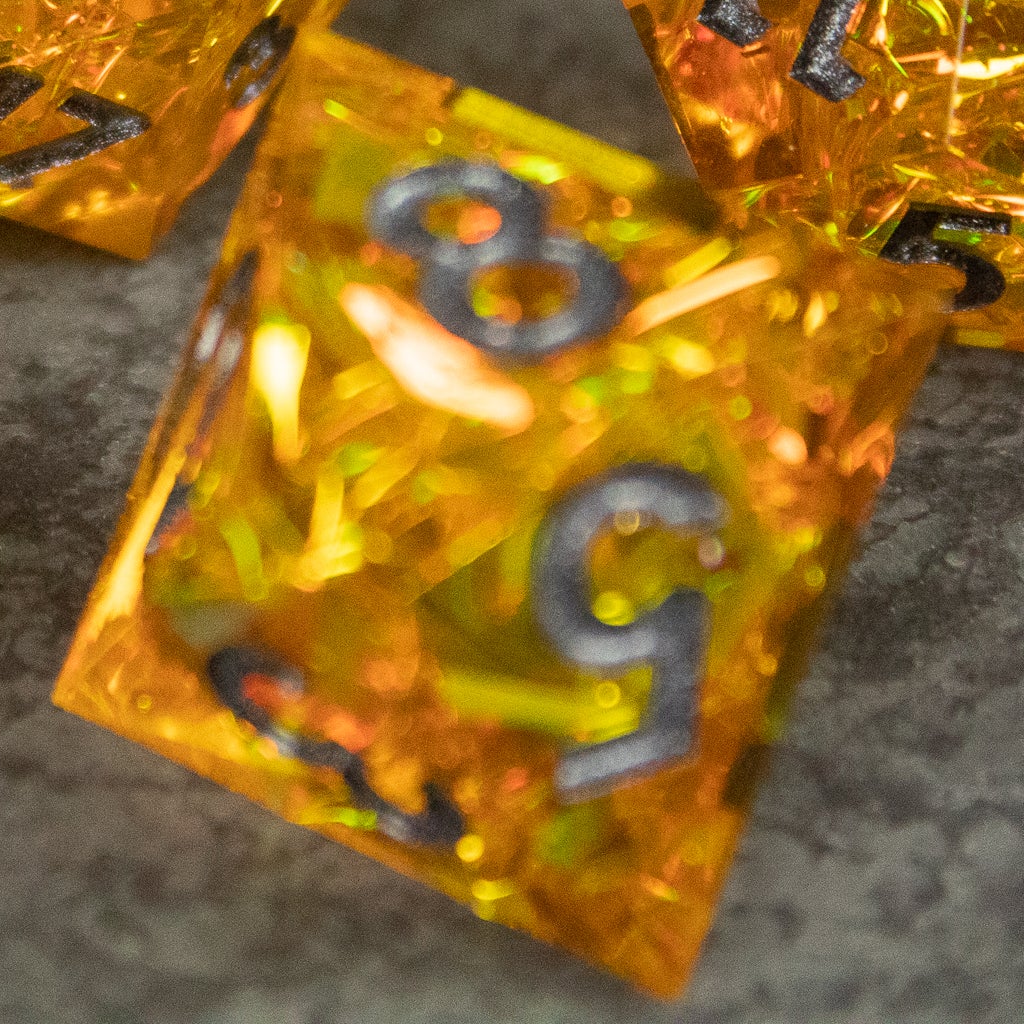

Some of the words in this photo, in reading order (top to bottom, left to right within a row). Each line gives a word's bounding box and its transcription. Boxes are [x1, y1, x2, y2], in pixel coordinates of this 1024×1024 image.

[367, 160, 627, 357] 8
[878, 202, 1012, 312] 5
[532, 461, 729, 800] 5
